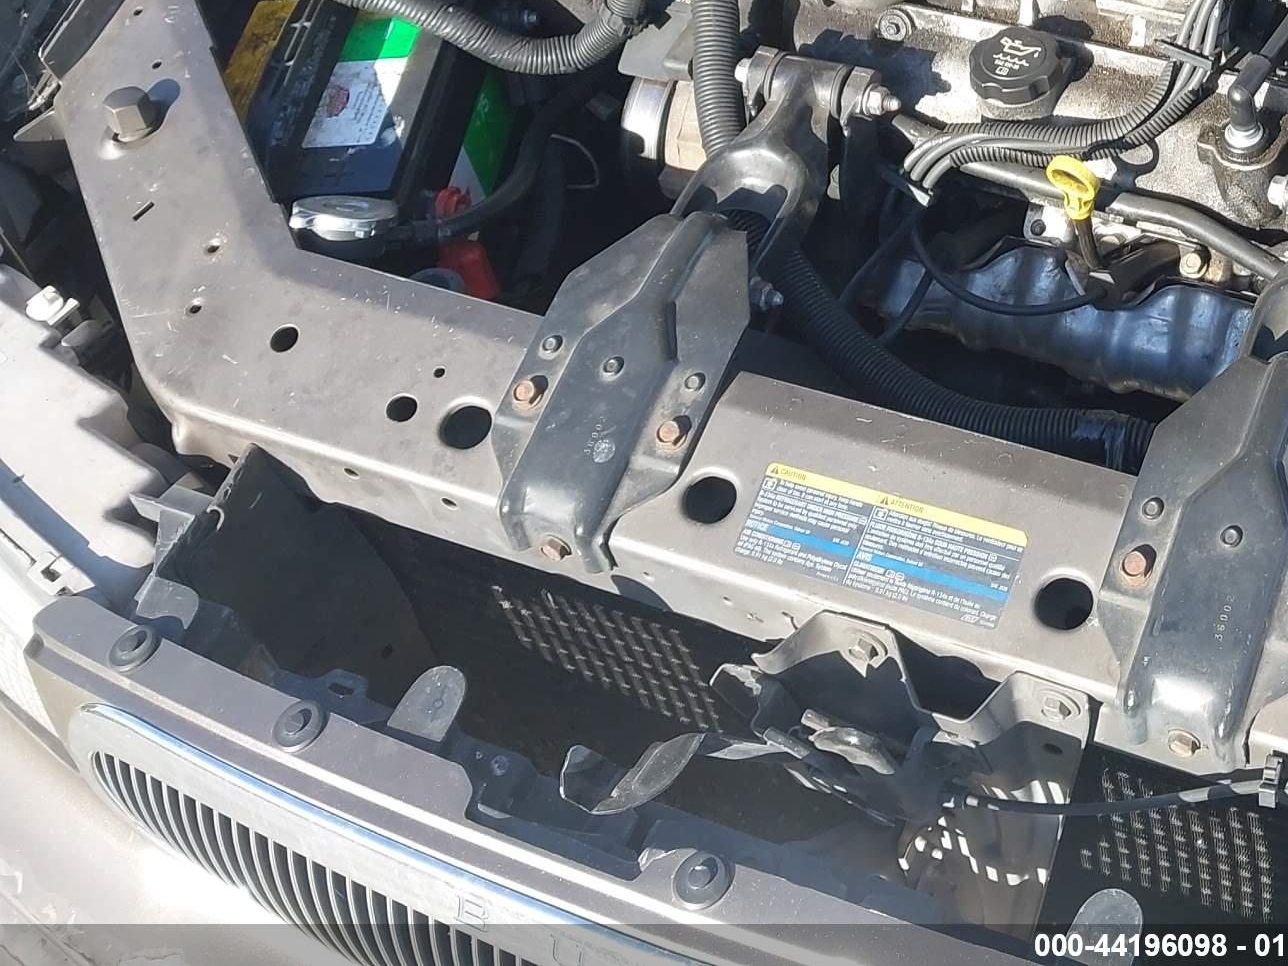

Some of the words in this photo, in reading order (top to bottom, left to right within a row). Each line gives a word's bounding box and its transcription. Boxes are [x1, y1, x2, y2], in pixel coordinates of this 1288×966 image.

[780, 468, 806, 480] CAUTION
[890, 499, 923, 512] ATTENTION
[856, 551, 872, 561] AVIS
[1214, 595, 1235, 642] 36002
